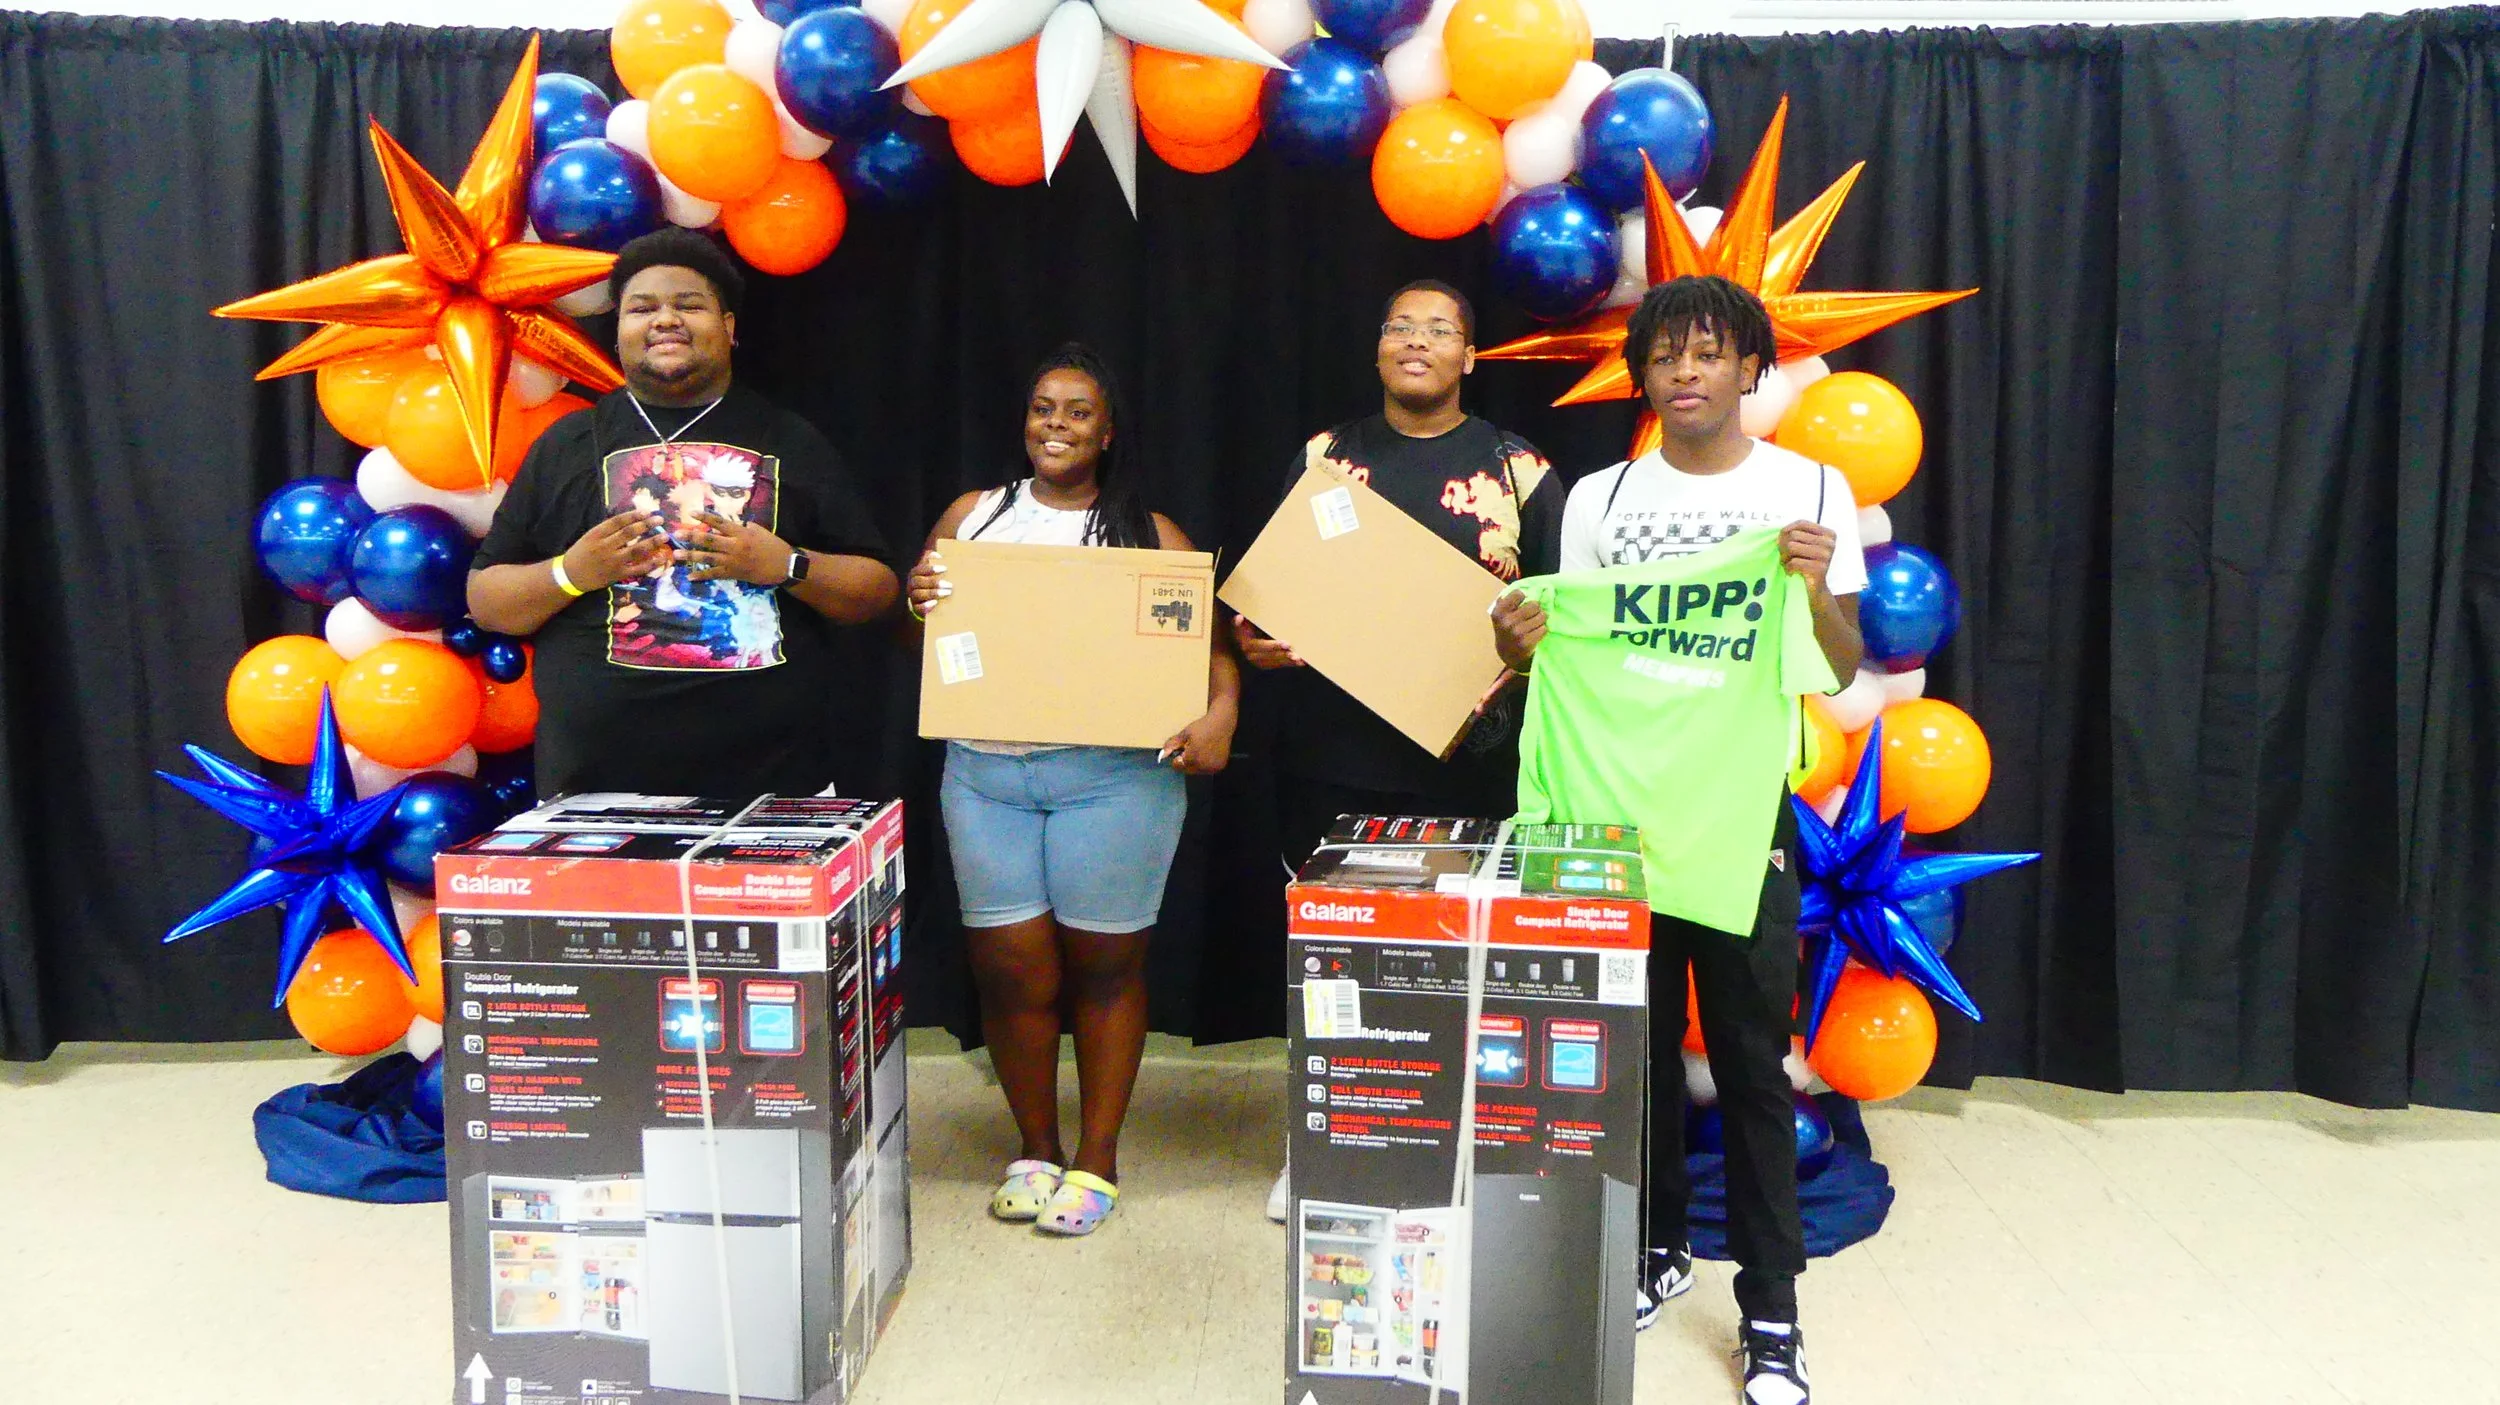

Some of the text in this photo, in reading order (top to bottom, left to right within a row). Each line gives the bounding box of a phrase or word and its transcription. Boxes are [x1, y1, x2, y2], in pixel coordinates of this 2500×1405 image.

[1670, 512, 1706, 520] THE
[1153, 588, 1193, 597] UN 3481
[451, 874, 532, 895] Galanz
[745, 874, 813, 885] Double Door
[694, 884, 813, 898] Compact Refrigerator
[1300, 902, 1375, 923] Galanz
[1567, 906, 1628, 918] Single Door
[453, 916, 503, 925] Colors available
[557, 919, 610, 928] Models available
[1515, 916, 1629, 931] Compact Refrigerator
[1326, 946, 1352, 954] available
[1382, 949, 1405, 957] Models
[464, 973, 512, 981] Double Door
[464, 982, 579, 996] Compact Refrigerator
[1481, 1019, 1513, 1028] COMPACT
[1361, 1027, 1431, 1043] Refrigerator
[488, 1036, 599, 1046] MECHANICAL TEMPERATURE
[656, 1065, 683, 1074] MORE
[1331, 1057, 1442, 1072] 2 LITER BOTTLE STORAGE
[1330, 1085, 1421, 1098] FULL WIDTH CHILLER
[1492, 1106, 1538, 1116] FEATURES
[1330, 1113, 1452, 1129] MECHANICAL TEMPERATURE
[1330, 1123, 1370, 1134] CONTROL
